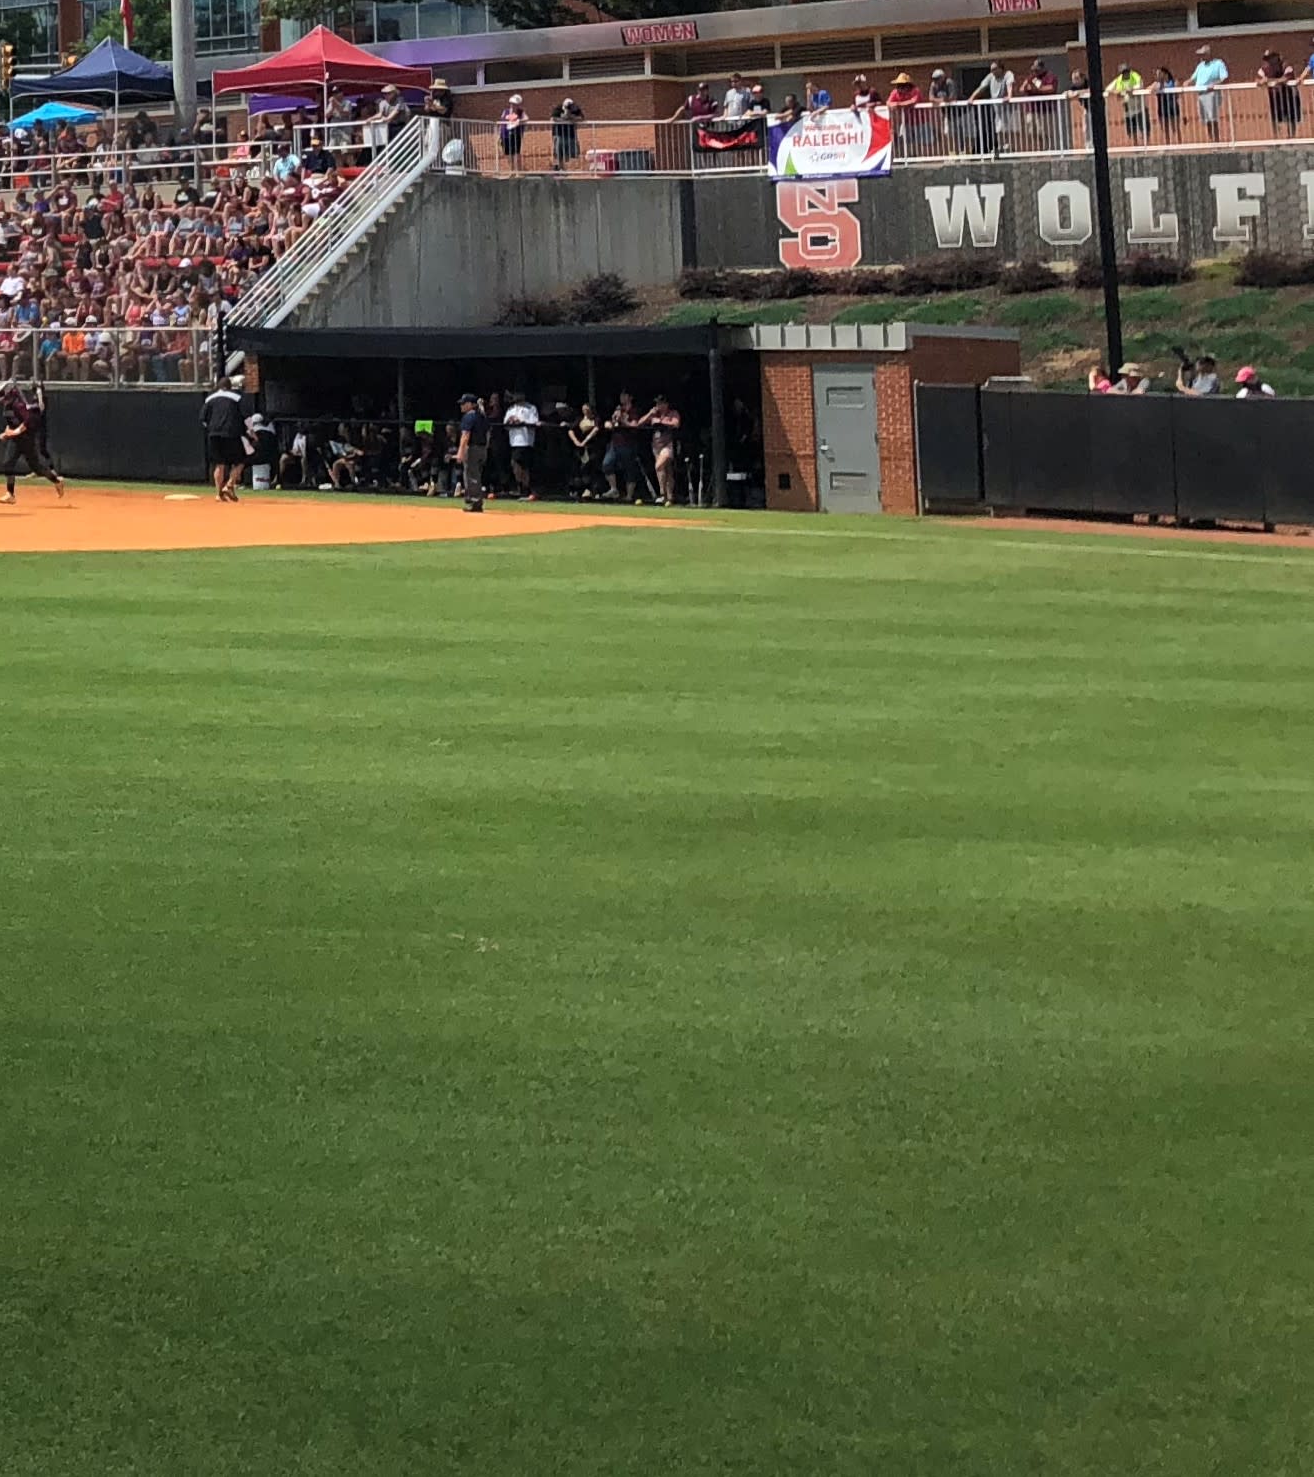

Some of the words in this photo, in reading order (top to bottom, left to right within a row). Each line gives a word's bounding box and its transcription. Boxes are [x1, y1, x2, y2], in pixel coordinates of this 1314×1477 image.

[624, 23, 695, 45] WOMEN
[792, 131, 864, 147] RALEIGH!
[924, 171, 1314, 249] WOLF
